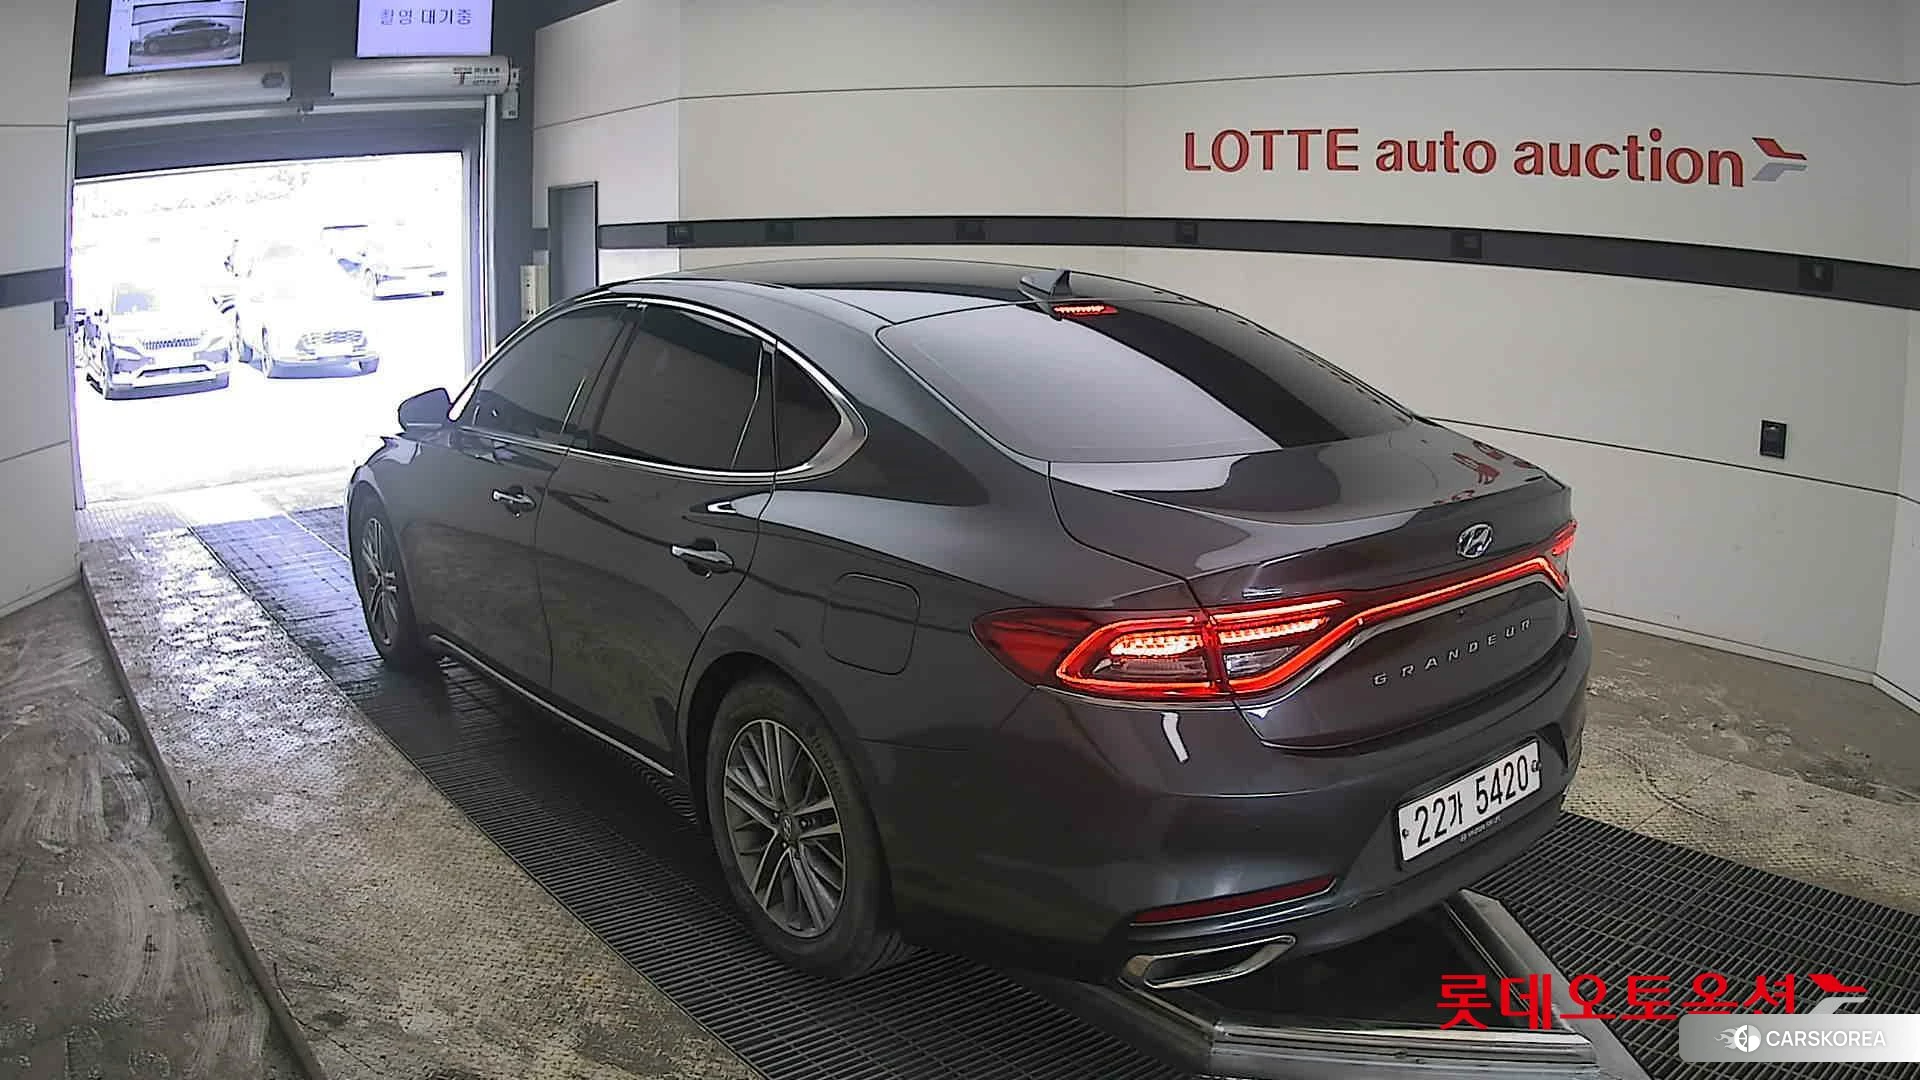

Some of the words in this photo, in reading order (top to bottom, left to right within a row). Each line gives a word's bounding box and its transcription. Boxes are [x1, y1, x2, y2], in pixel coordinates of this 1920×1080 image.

[1184, 127, 1359, 172] LOTTE
[1375, 131, 1497, 175] auto
[1513, 129, 1745, 188] auction
[1372, 619, 1532, 686] GRANDEUR
[1414, 791, 1463, 848] 22가
[1475, 755, 1529, 816] 5420
